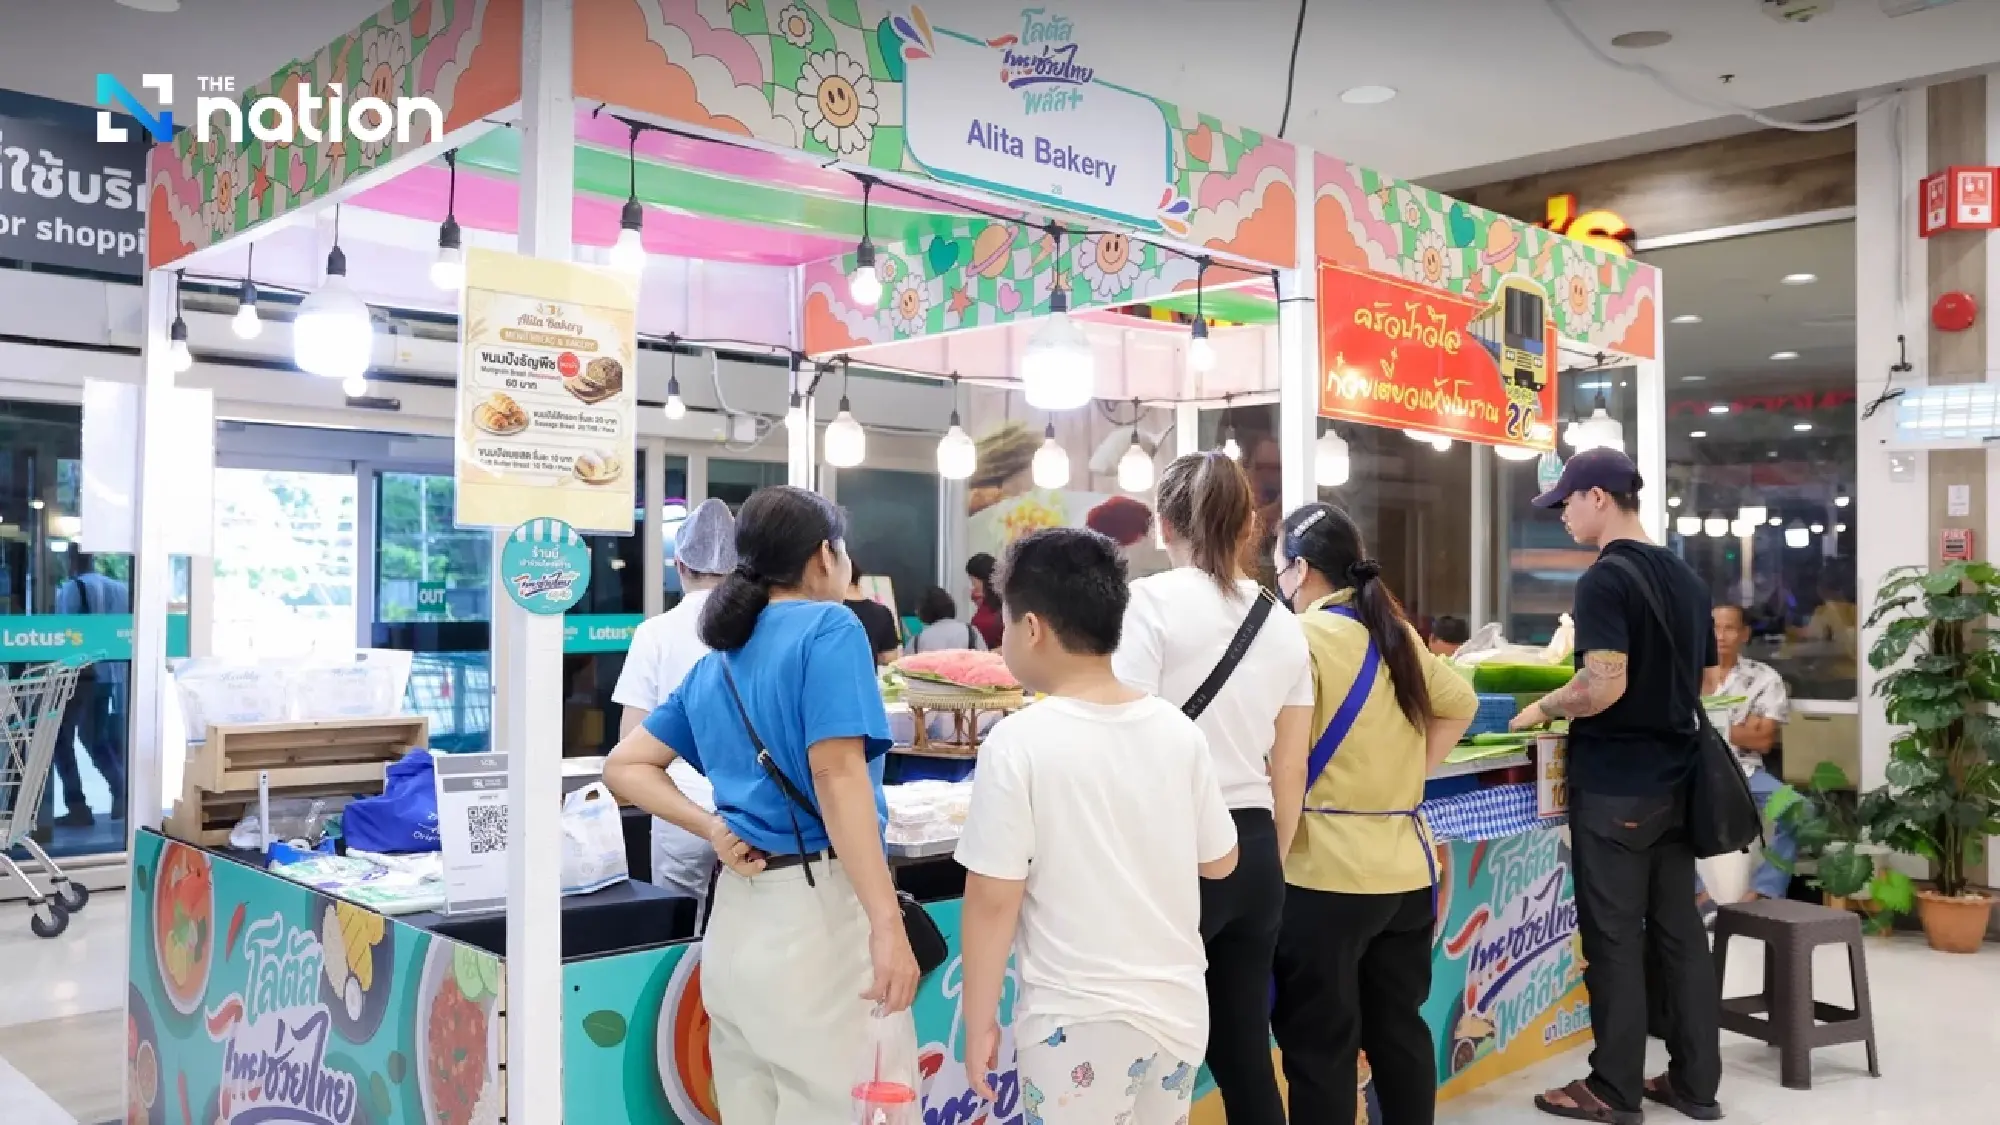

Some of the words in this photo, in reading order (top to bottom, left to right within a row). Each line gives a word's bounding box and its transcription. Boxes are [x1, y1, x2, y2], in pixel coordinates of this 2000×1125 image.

[1019, 7, 1075, 46] โลตัส
[986, 34, 1094, 83] ไทยช่วยไทย
[1023, 85, 1084, 115] พลัส+
[967, 119, 1023, 159] Alita
[1034, 135, 1117, 187] Bakery
[482, 351, 556, 371] ขนมปังธัญพืช
[505, 378, 518, 389] 60
[520, 381, 538, 390] บาท
[420, 588, 445, 604] OUT
[4, 628, 84, 647] Lotus's
[246, 913, 323, 1027] โลตัส
[1496, 952, 1571, 1048] พลัส+
